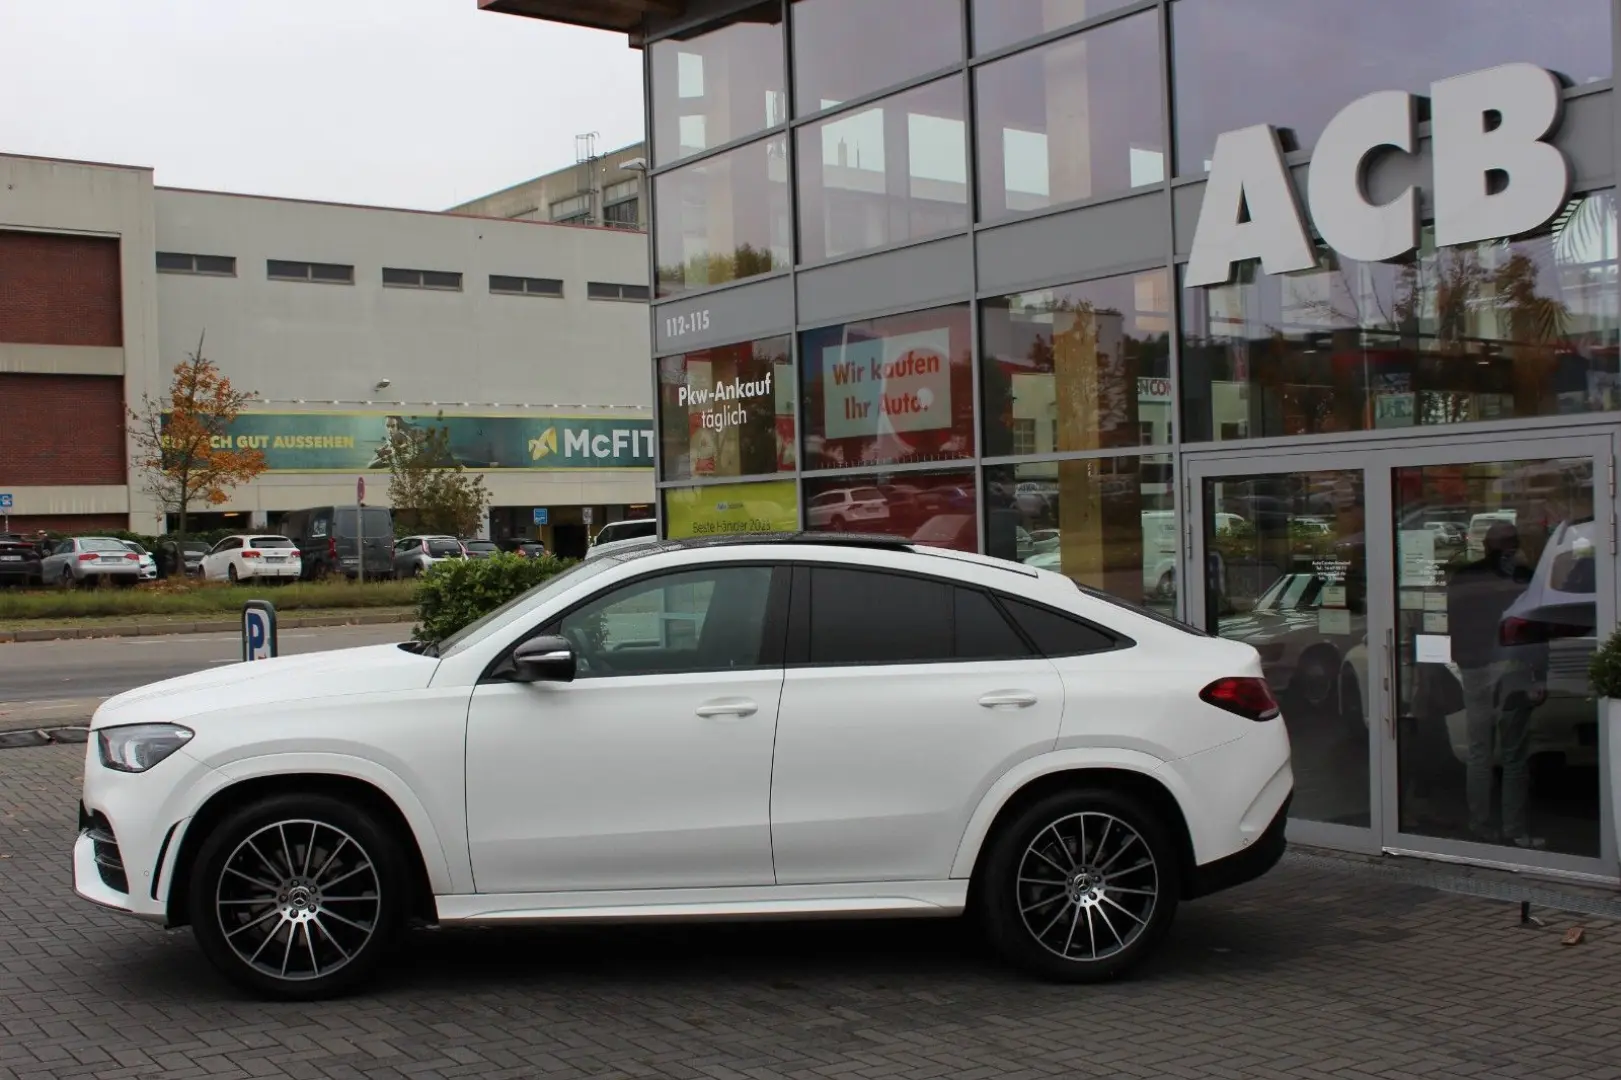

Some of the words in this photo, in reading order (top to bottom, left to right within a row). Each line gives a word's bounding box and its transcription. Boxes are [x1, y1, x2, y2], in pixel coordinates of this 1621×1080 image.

[1185, 62, 1571, 288] ACB
[666, 309, 710, 337] 112-115
[832, 361, 865, 386] Wir
[870, 350, 939, 381] kaufen
[678, 371, 771, 407] Pkw-Ankauf
[701, 402, 747, 432] täglich
[844, 395, 871, 420] Ihr
[236, 435, 269, 449] GUT
[273, 435, 355, 449] AUSSEHEN
[564, 428, 655, 458] McFIT
[692, 521, 715, 533] Beste
[247, 612, 265, 661] P
